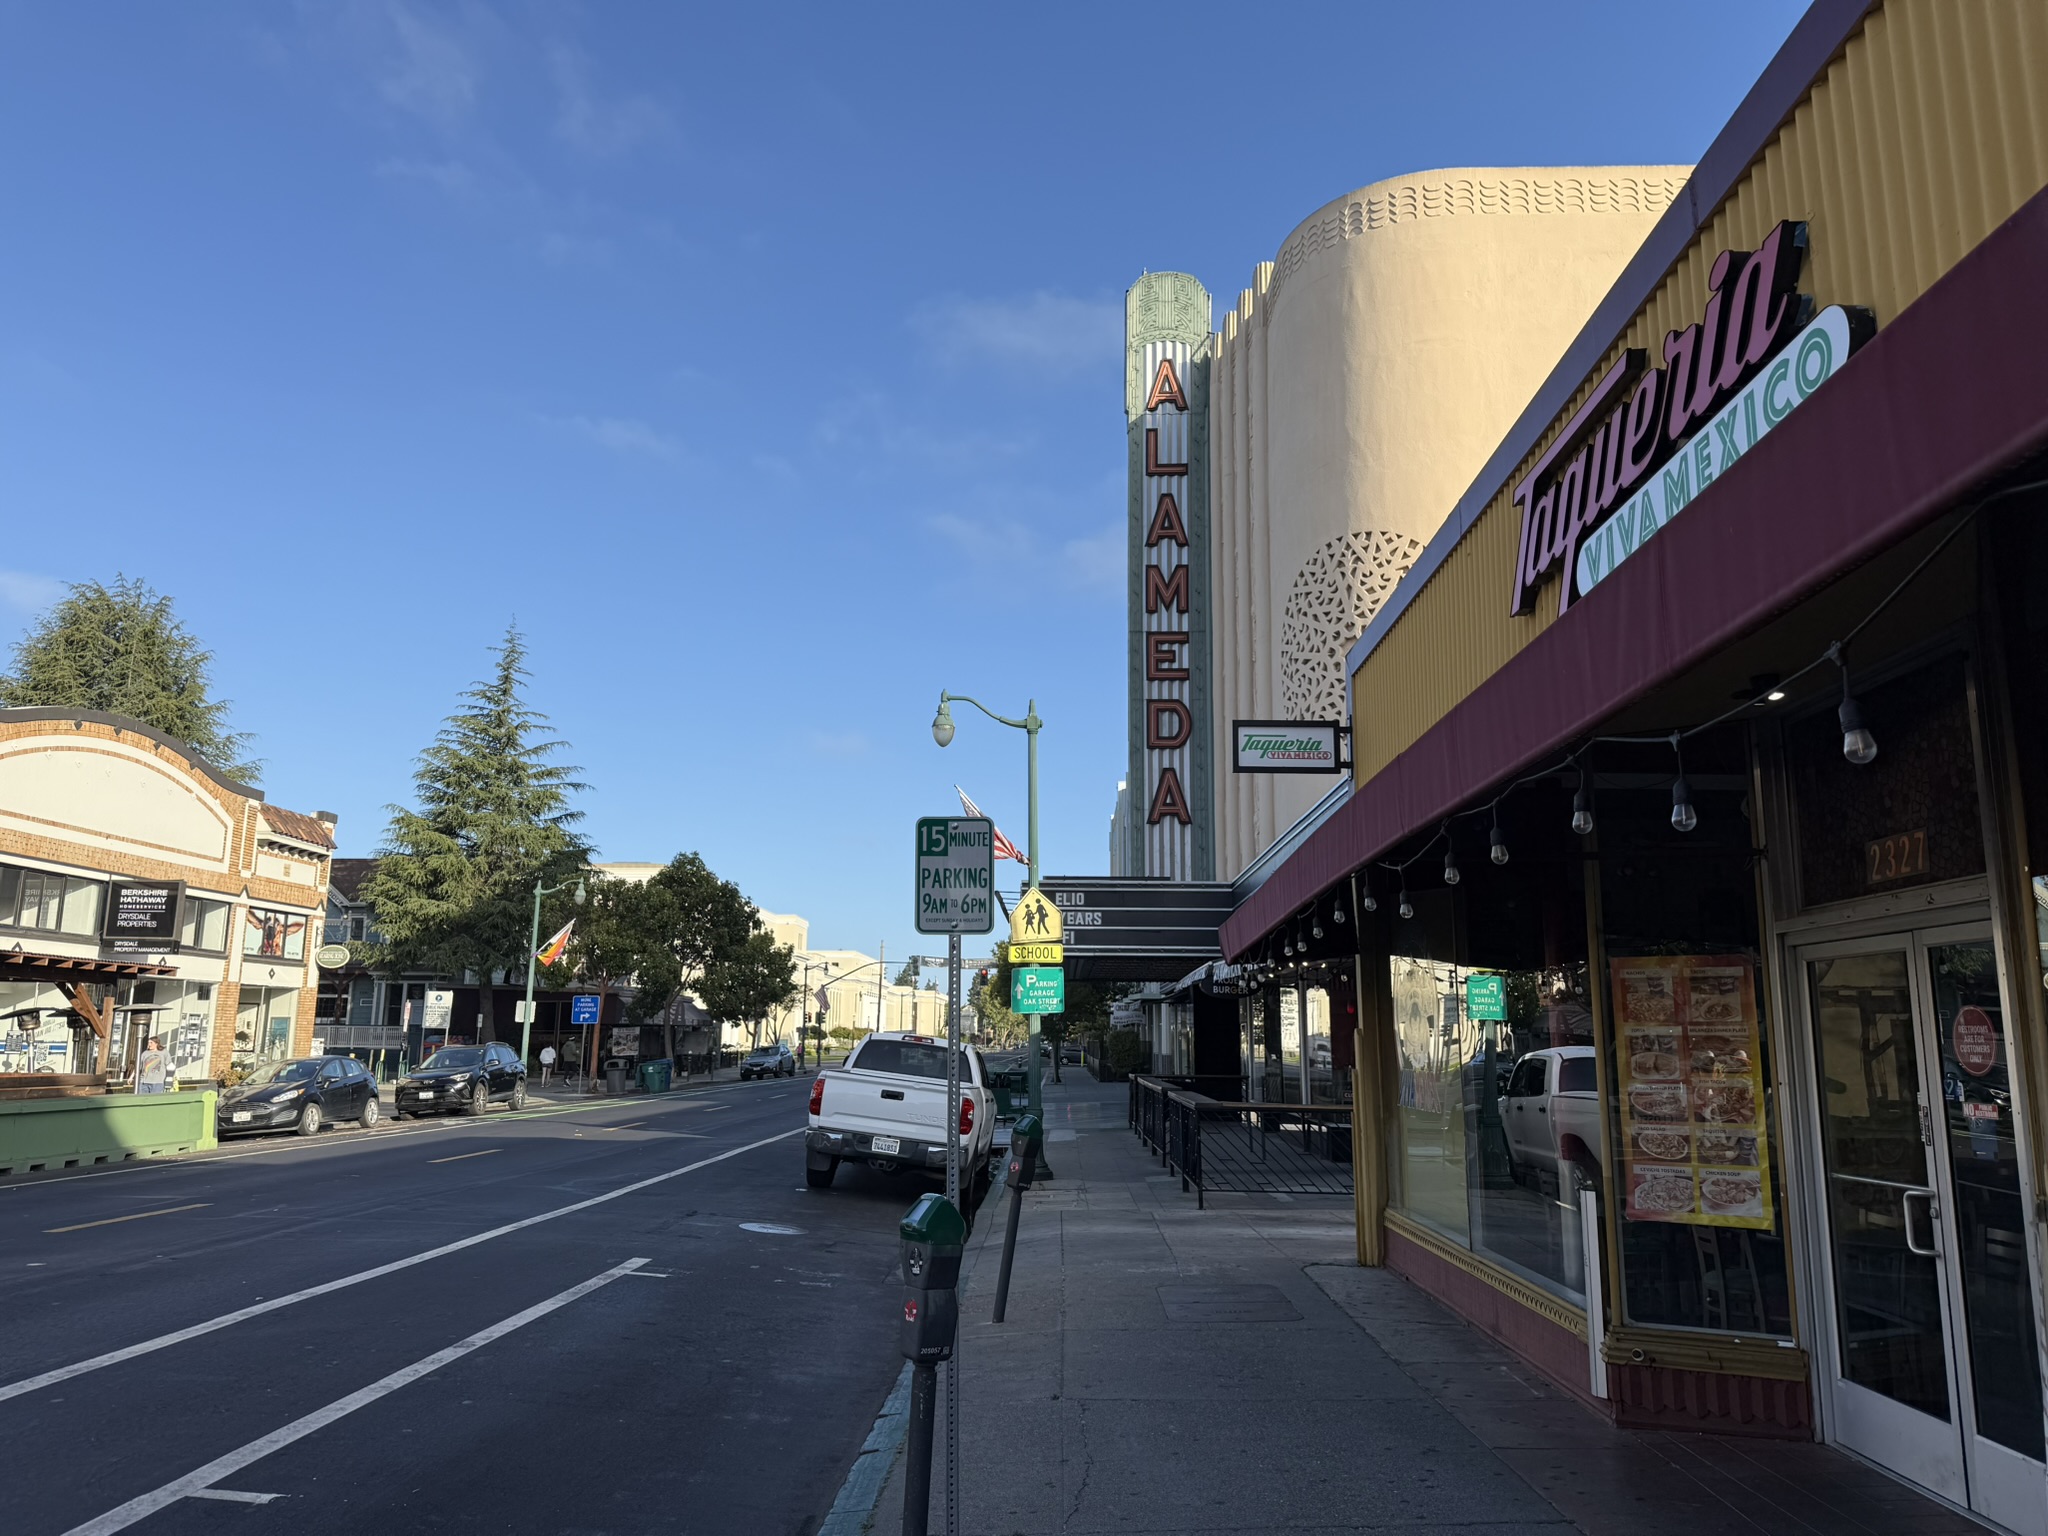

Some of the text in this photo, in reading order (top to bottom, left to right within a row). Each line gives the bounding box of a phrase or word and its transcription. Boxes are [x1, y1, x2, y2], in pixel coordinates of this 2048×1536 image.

[1510, 219, 1796, 619] Taqueria
[1584, 327, 1833, 586] VIVA MEXICO
[1144, 358, 1193, 825] ALAMEDA
[1241, 734, 1323, 759] Taqueria
[1270, 751, 1329, 759] VIVA MEXICO
[920, 825, 989, 852] 15 MINUTE
[1870, 831, 1924, 881] 2327
[921, 867, 988, 889] PARKING
[120, 896, 167, 904] HATHAWAY
[922, 893, 987, 914] 9AM TO 6PM
[1055, 892, 1085, 906] ELIO
[1014, 946, 1057, 960] SCHOOL
[1213, 985, 1249, 995] BURGER
[1958, 1025, 1989, 1034] RESTROOMS
[1964, 1035, 1985, 1043] ARE FOR
[1960, 1045, 1990, 1053] CUSTOMERS
[1970, 1055, 1982, 1063] ONLY
[1963, 1104, 1975, 1116] NO
[906, 1111, 947, 1124] TUNDR
